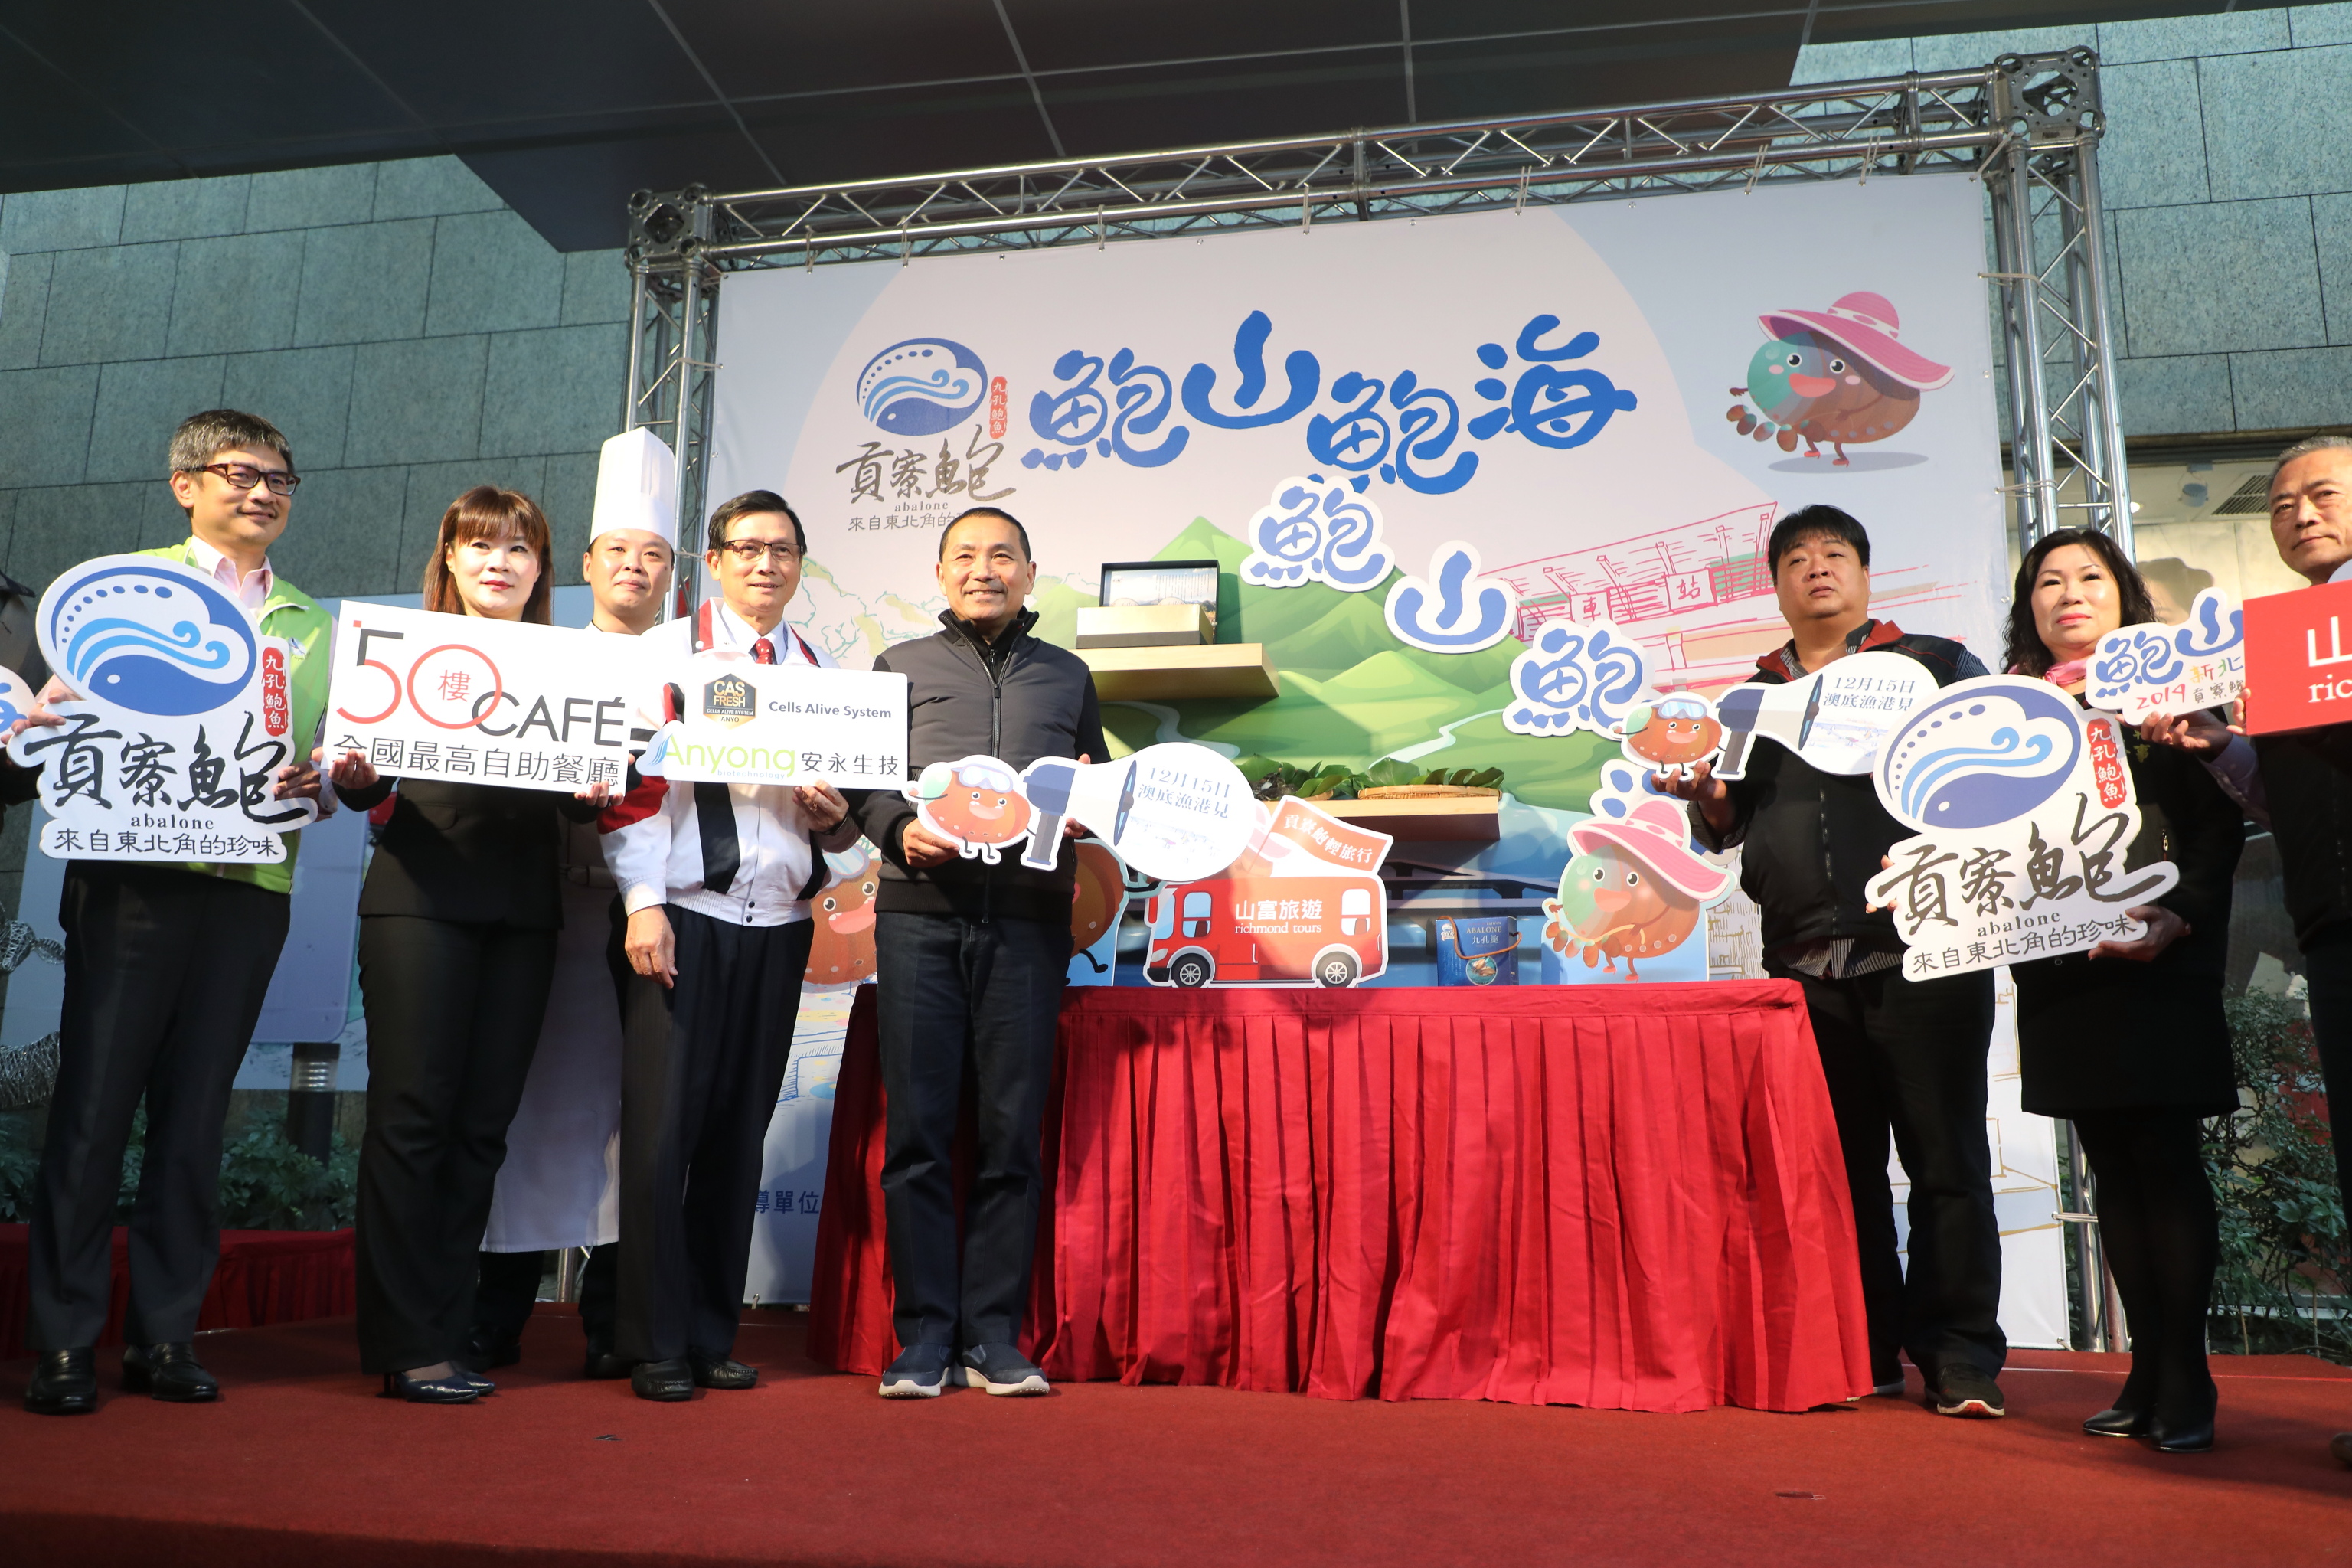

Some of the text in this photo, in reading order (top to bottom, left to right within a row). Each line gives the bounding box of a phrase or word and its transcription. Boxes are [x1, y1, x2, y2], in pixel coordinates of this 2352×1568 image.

[991, 381, 1006, 435] 九孔鮑魚
[1021, 309, 1638, 495] 鮑山鮑海
[894, 501, 949, 512] abalone
[848, 511, 963, 531] 來自東北角的
[1250, 485, 1386, 584] 鮑
[1394, 550, 1507, 646] 山
[1676, 575, 1701, 600] 站
[2307, 616, 2352, 668] 山
[264, 655, 286, 729] 九孔鮑魚
[714, 680, 746, 697] CAS
[1833, 676, 1916, 694] 12月15日
[2135, 684, 2186, 710] 2019
[714, 695, 746, 707] FRESH
[769, 701, 892, 718] Cells Alive System
[1823, 692, 1913, 712] 澳底漁港見
[472, 690, 626, 747] CAFÉ
[665, 734, 795, 778] Anyong
[801, 750, 899, 776] 安永生技
[2089, 726, 2123, 802] 九孔鮑魚
[717, 769, 786, 781] biotechnology
[129, 813, 215, 830] abalone
[54, 829, 280, 858] 來自東北角的珍味
[1235, 898, 1323, 920] 山富旅遊
[1234, 921, 1322, 934] richmond tours
[1465, 926, 1502, 934] ABALONE
[1977, 910, 2062, 937] abalone
[1912, 911, 2138, 974] 來自東北角的珍味
